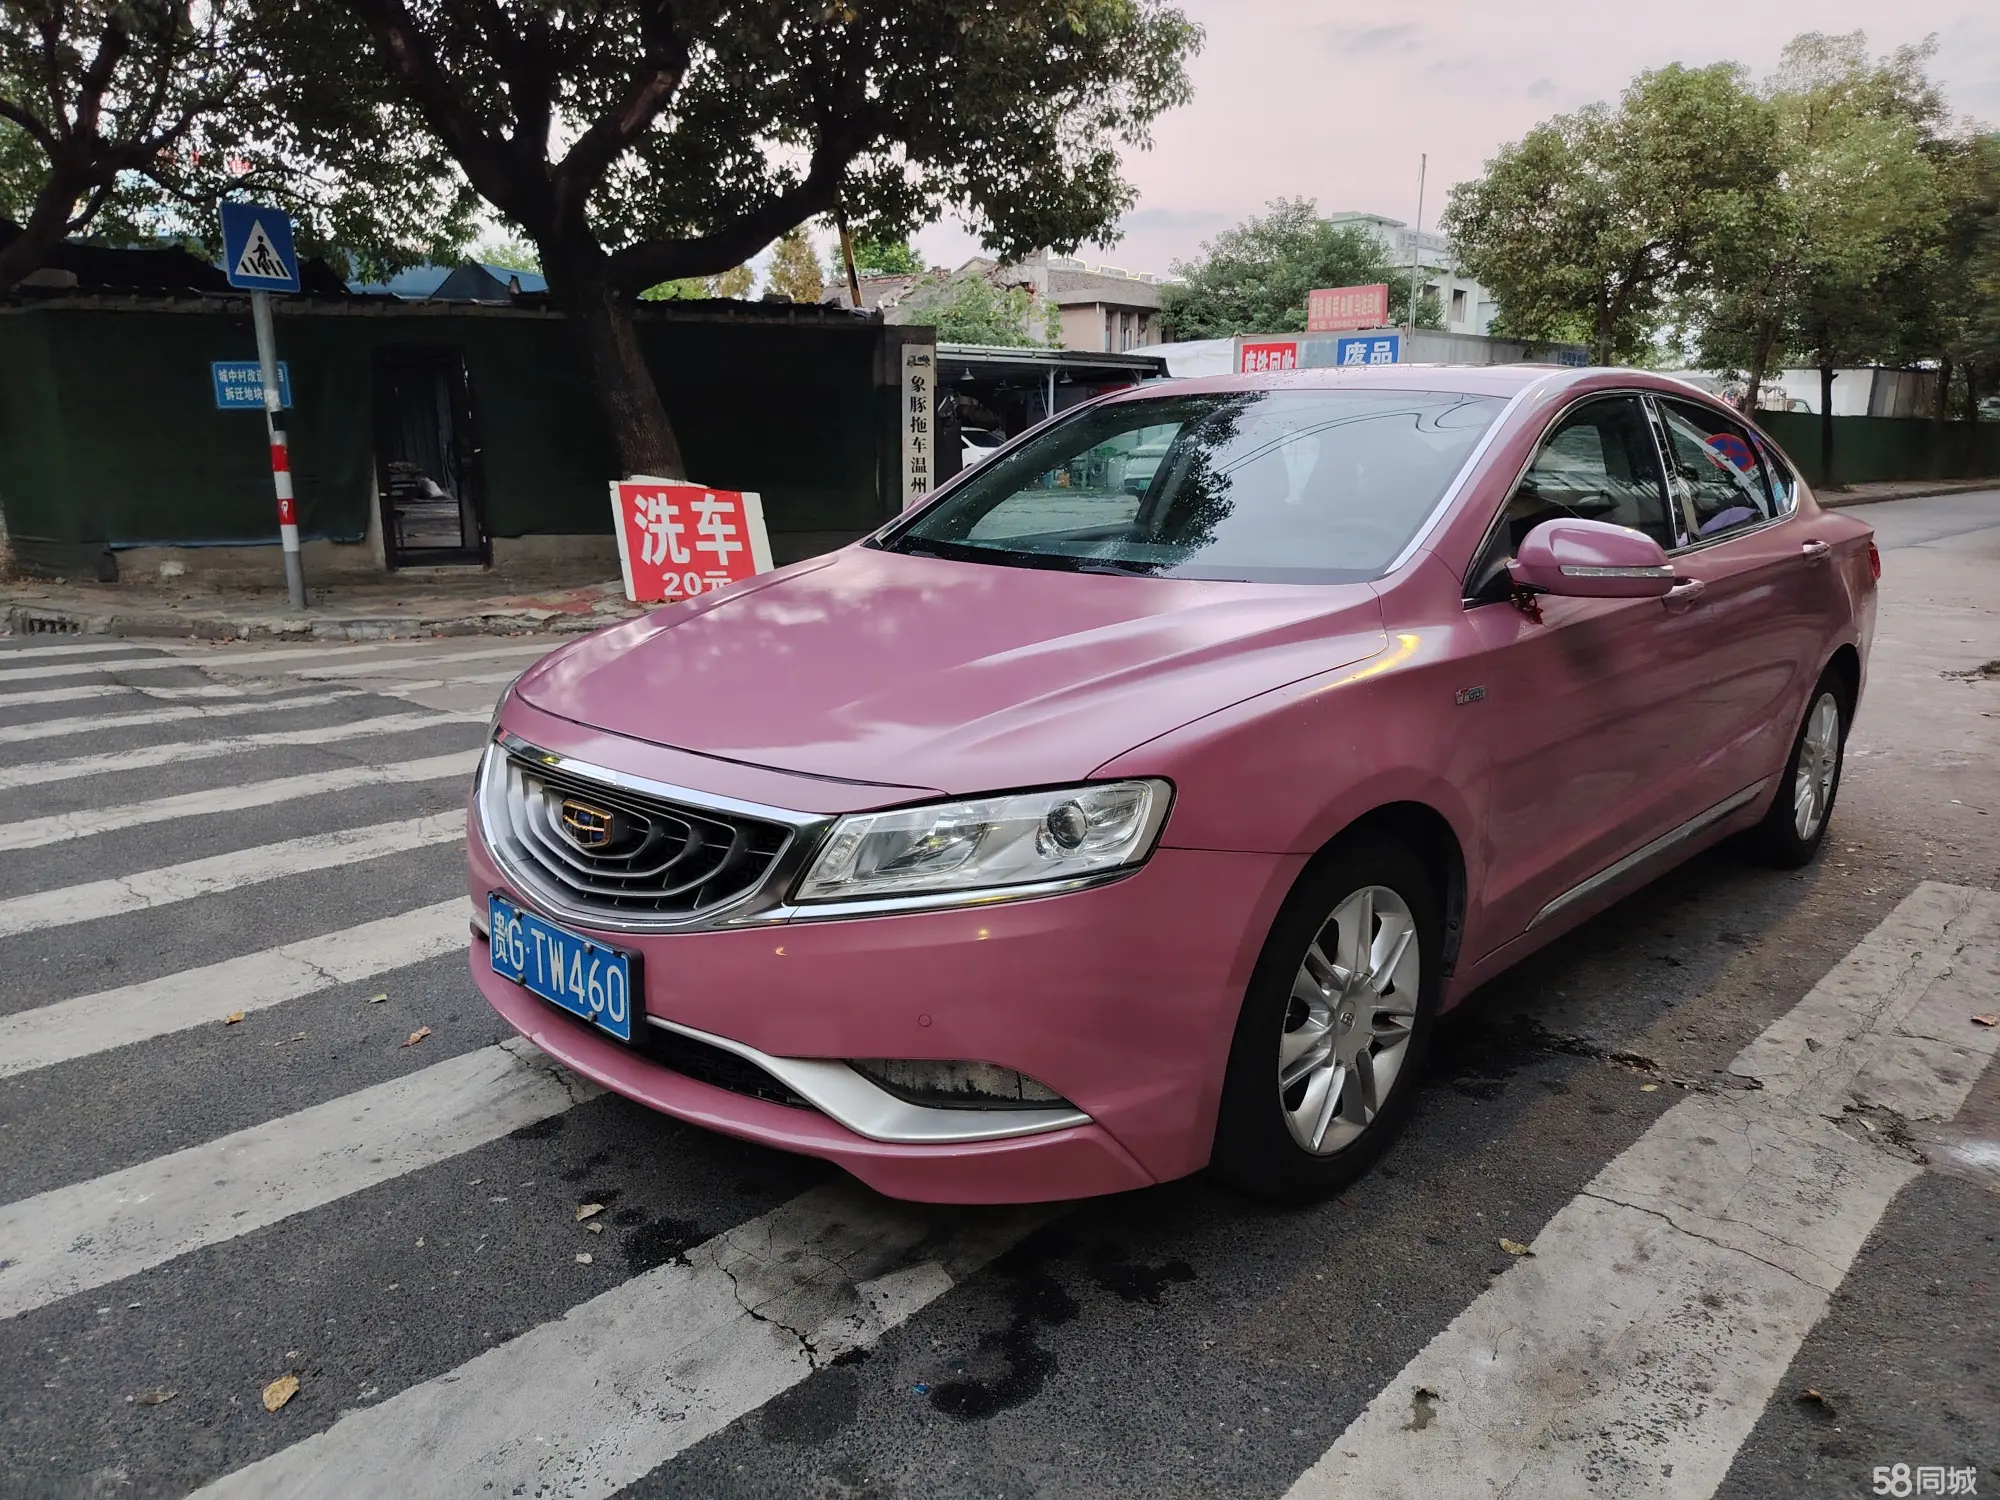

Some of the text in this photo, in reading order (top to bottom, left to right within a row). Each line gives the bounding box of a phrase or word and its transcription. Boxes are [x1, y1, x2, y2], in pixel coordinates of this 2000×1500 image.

[1244, 348, 1295, 373] 废铁回收
[1343, 341, 1392, 365] 废品
[218, 368, 284, 383] 城中村改造目
[910, 375, 928, 494] 象豚拖车温州
[634, 492, 743, 566] 洗车
[662, 570, 733, 596] 20元
